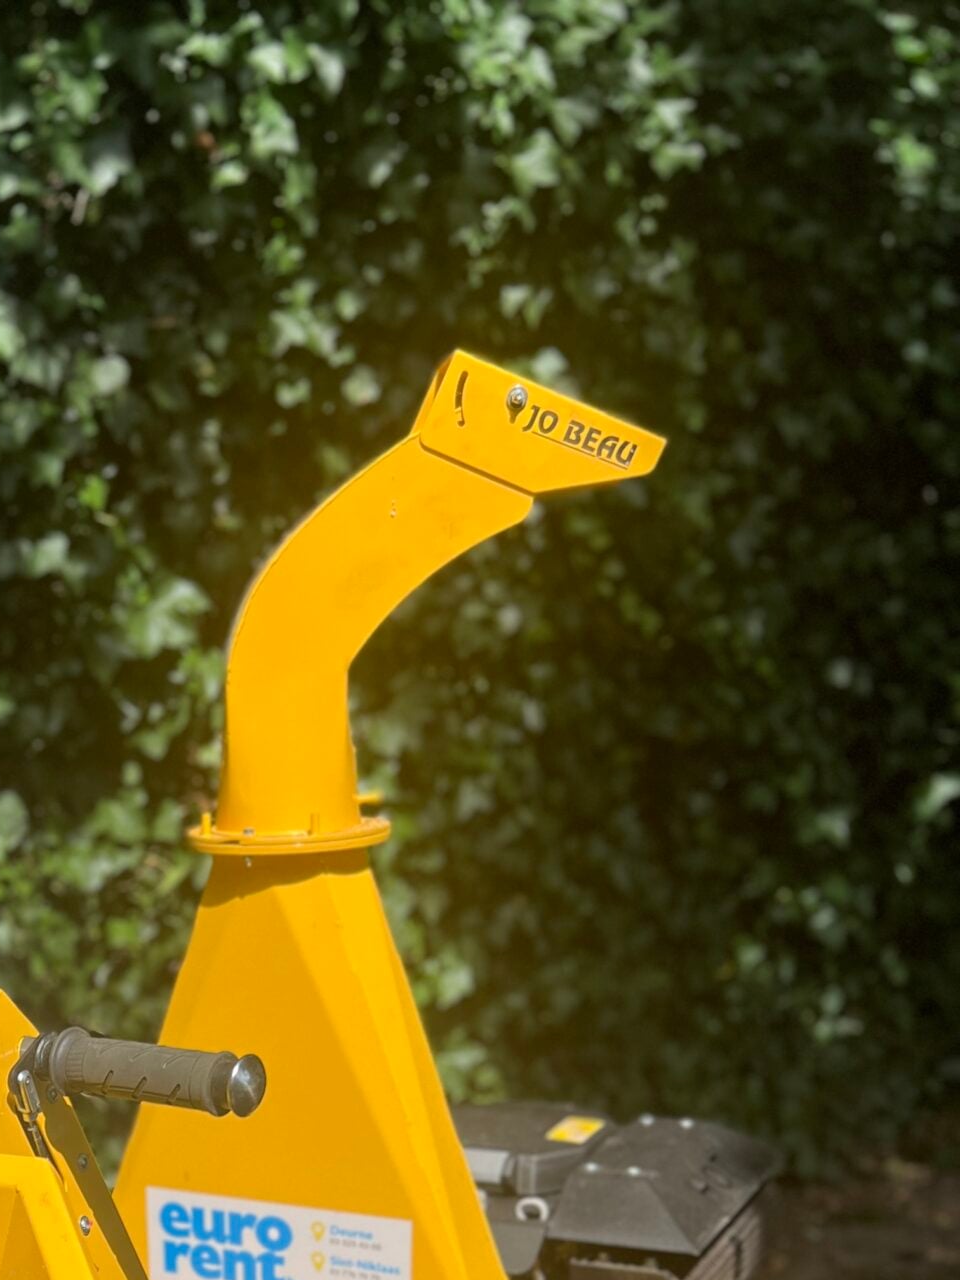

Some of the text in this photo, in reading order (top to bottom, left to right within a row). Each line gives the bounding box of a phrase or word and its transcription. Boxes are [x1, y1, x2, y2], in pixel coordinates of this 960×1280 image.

[522, 404, 638, 466] JO BEAU
[159, 1202, 294, 1252] euro
